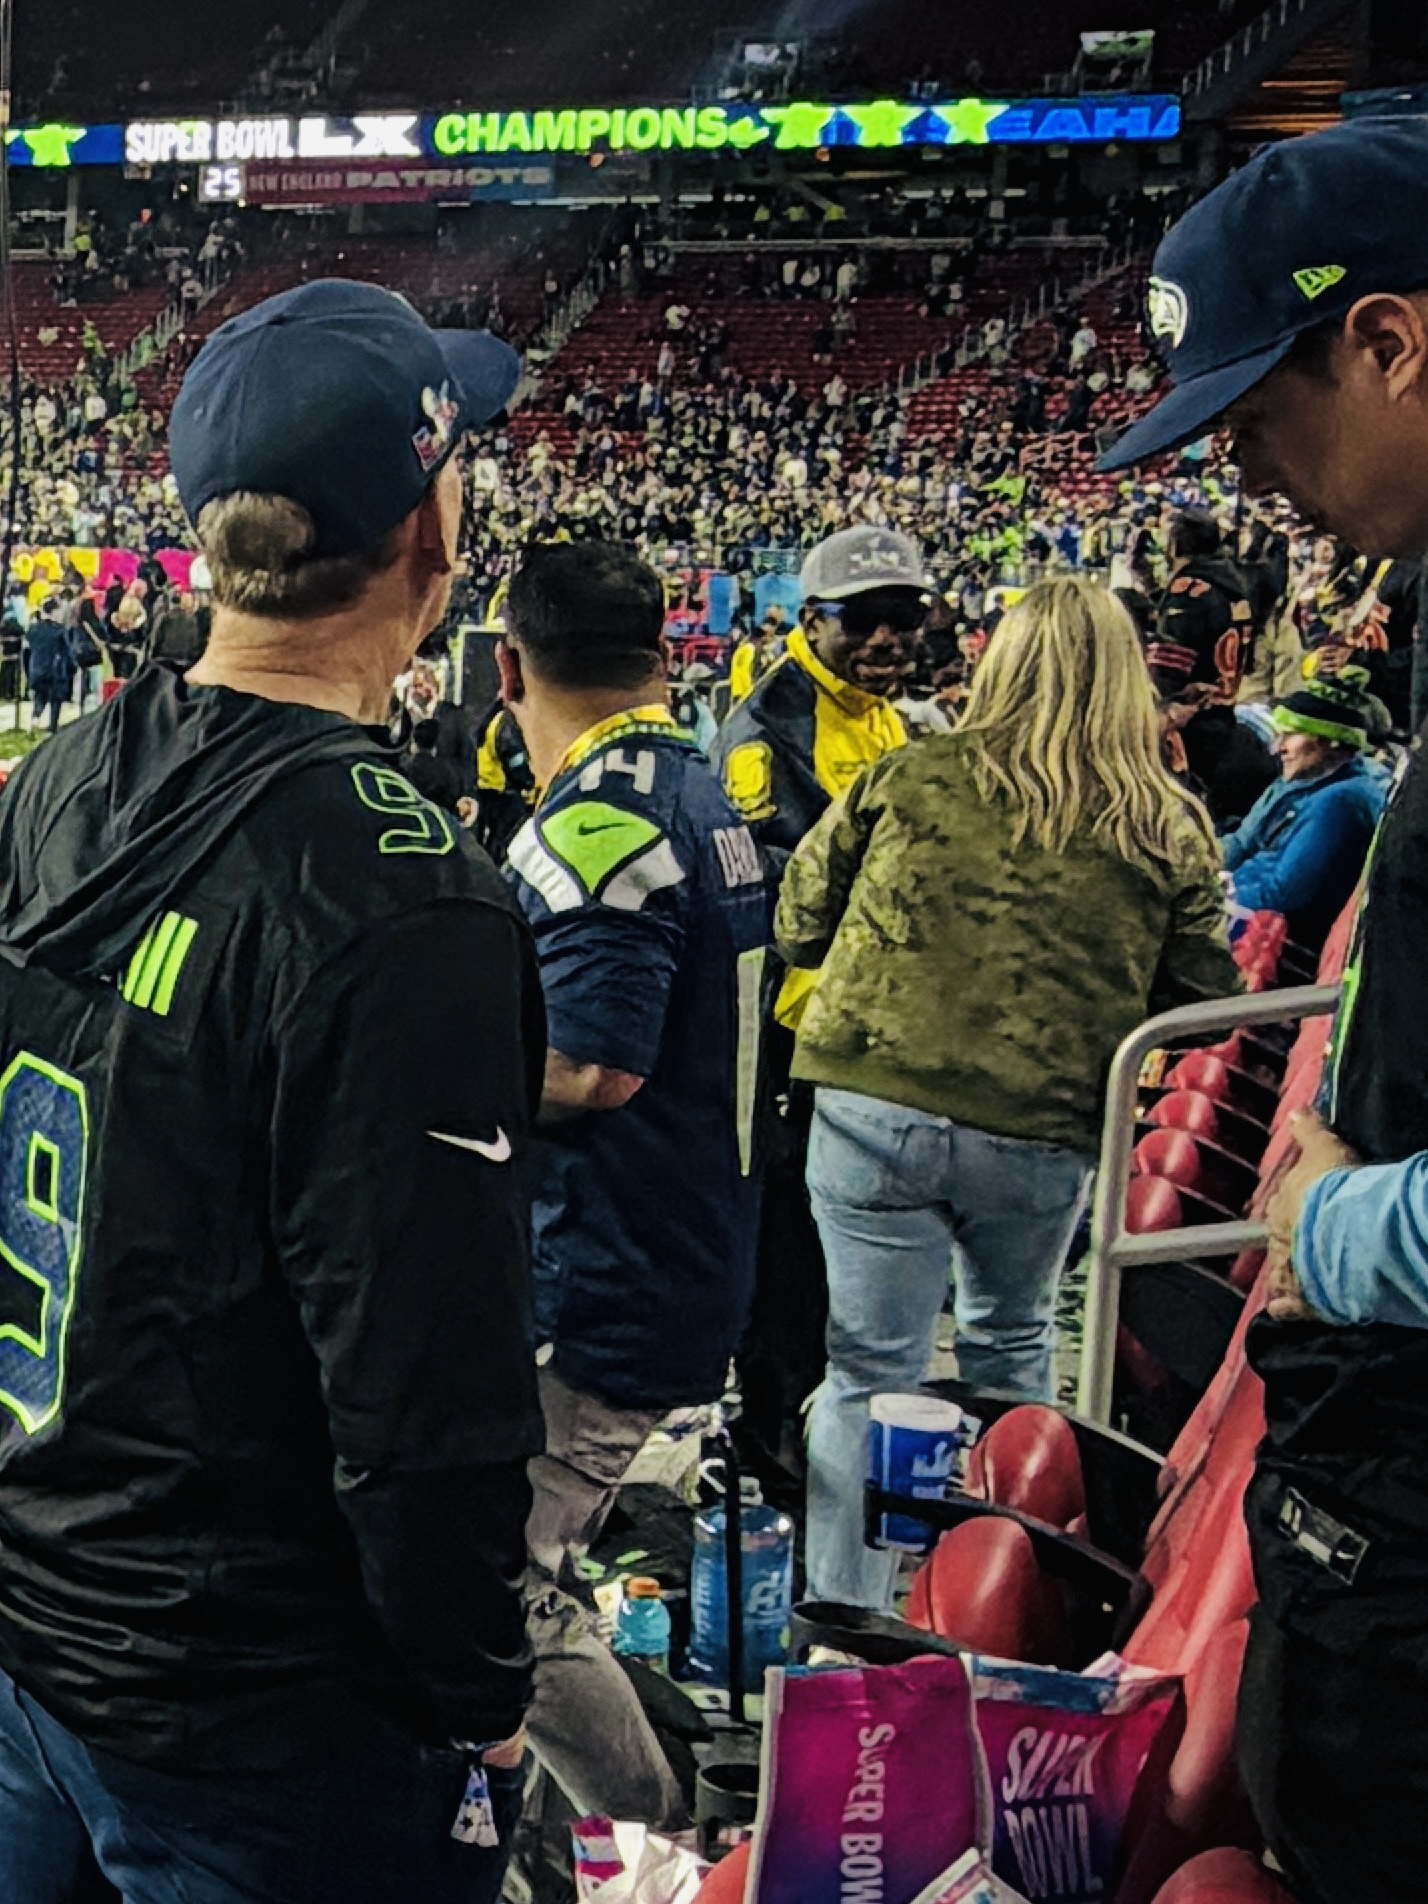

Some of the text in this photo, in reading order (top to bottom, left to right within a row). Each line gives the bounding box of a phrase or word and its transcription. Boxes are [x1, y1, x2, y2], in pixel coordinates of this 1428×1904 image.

[124, 106, 728, 163] SUPER BOWL LX CHAMPIONS
[345, 166, 552, 189] PATRIOTS
[351, 762, 455, 855] 9
[841, 1722, 898, 1824] SUPER
